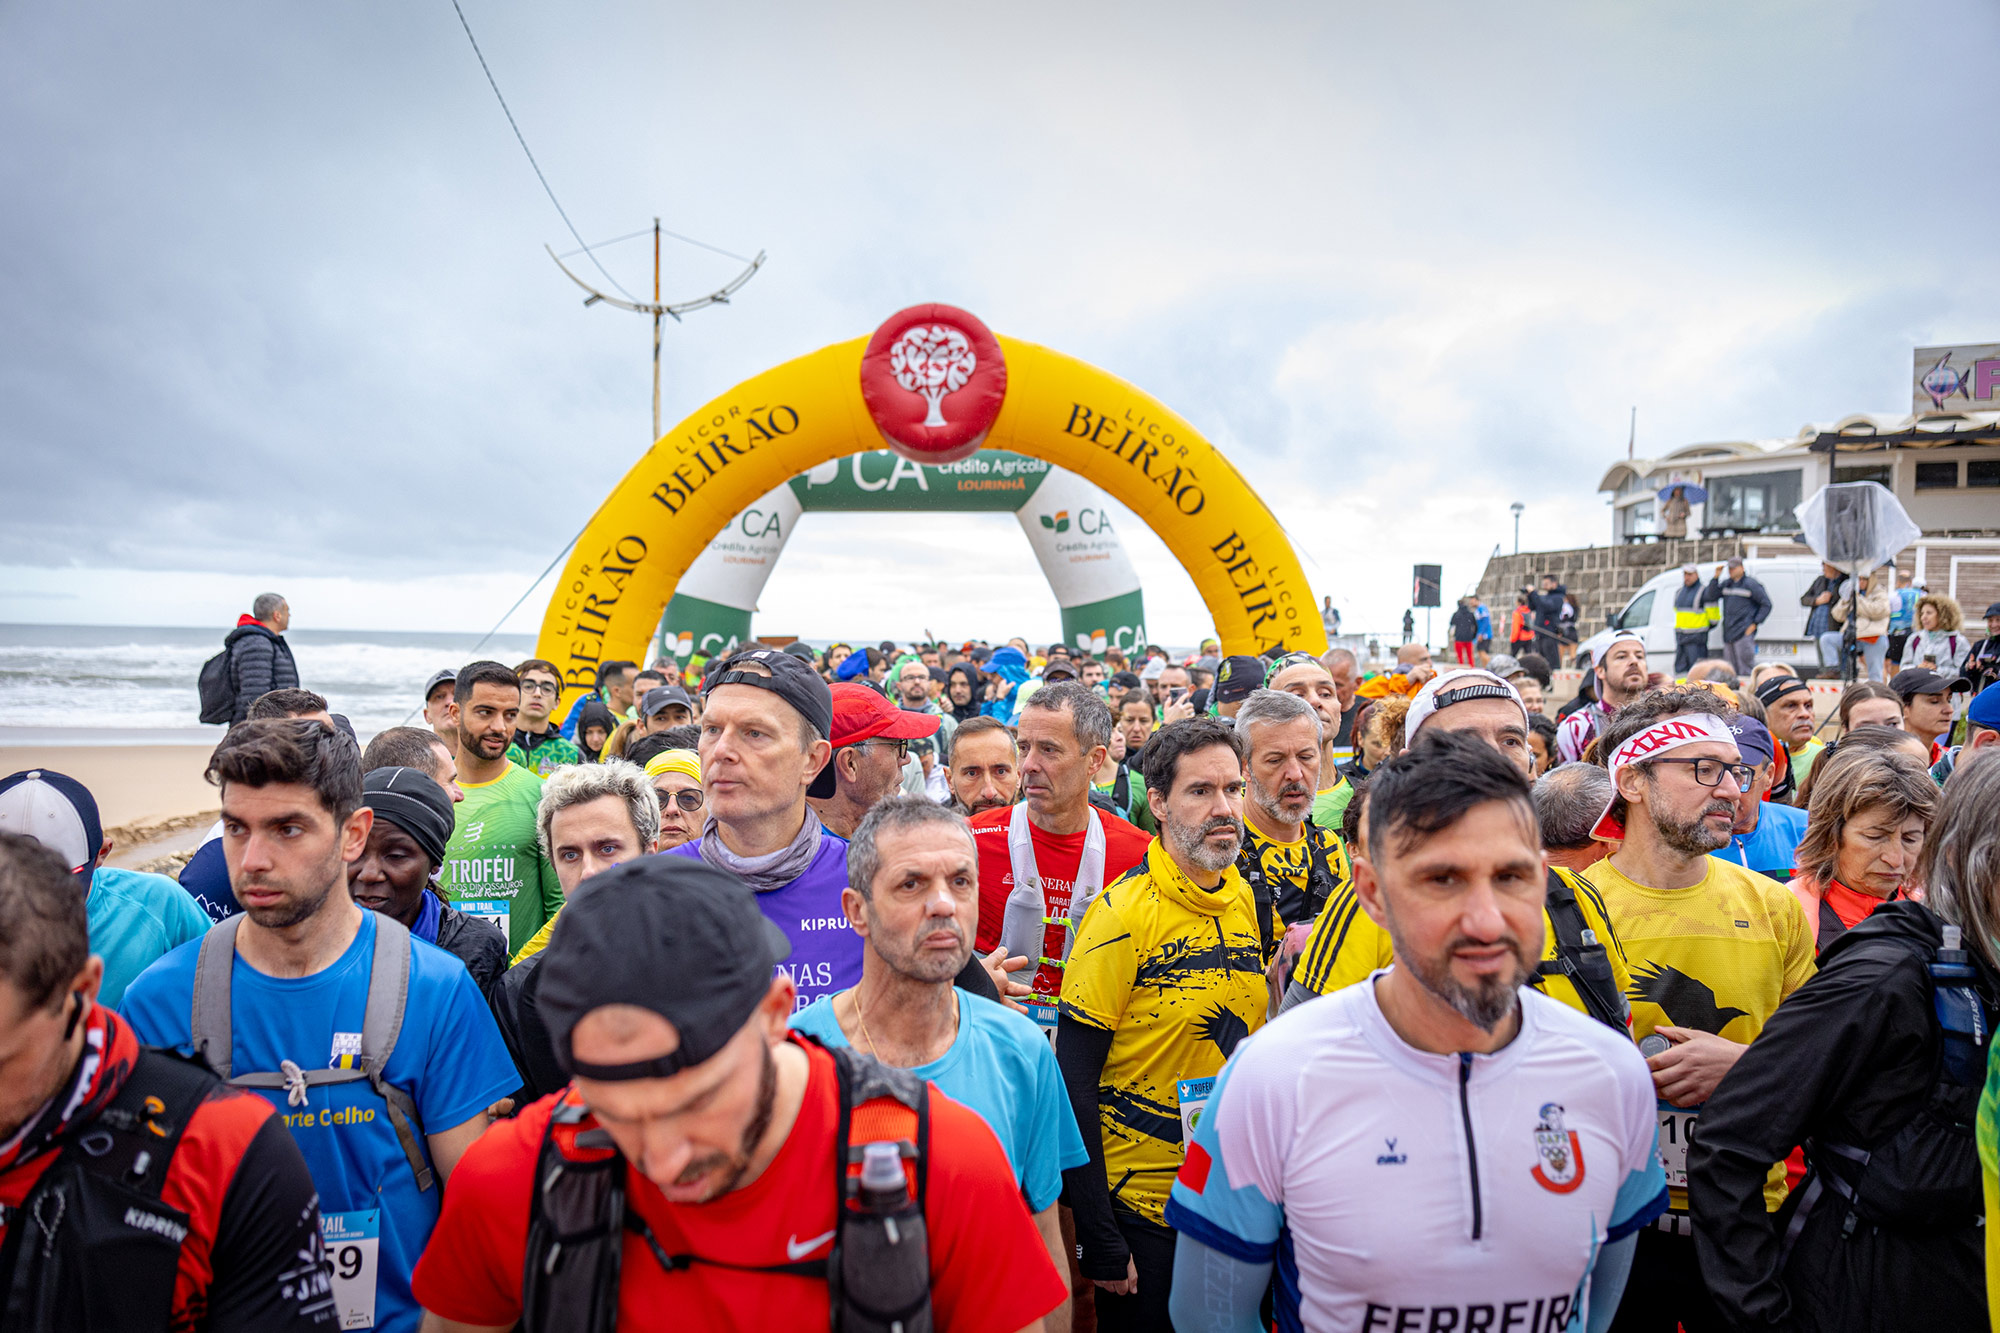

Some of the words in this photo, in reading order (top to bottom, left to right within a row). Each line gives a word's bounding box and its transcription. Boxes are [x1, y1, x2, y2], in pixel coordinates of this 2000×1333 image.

[676, 405, 741, 455] LICOR
[1125, 408, 1189, 459] LICOR
[650, 403, 800, 517] BEIRÃO
[852, 450, 930, 492] CA
[1063, 401, 1206, 516] BEIRÃO
[957, 477, 1026, 491] LOURINHÃ
[742, 509, 782, 539] CA
[1079, 508, 1114, 535] CA
[556, 564, 594, 637] LICOR
[1210, 529, 1291, 653] BEIR
[1269, 565, 1302, 638] LICOR
[566, 534, 648, 689] BEIRÃO
[1114, 624, 1148, 656] CA
[972, 825, 1002, 835] luanvi
[449, 854, 514, 884] TROFÉU
[449, 884, 468, 892] DOS
[469, 880, 524, 891] DINOSSAUROS
[461, 887, 484, 898] Trail
[484, 888, 519, 898] Running
[461, 903, 476, 912] MINI
[477, 902, 494, 911] TRAIL
[801, 917, 853, 931] KIPRU
[1037, 1008, 1055, 1020] MINI
[320, 1105, 375, 1127] Celho
[124, 1206, 189, 1243] KIPRUN
